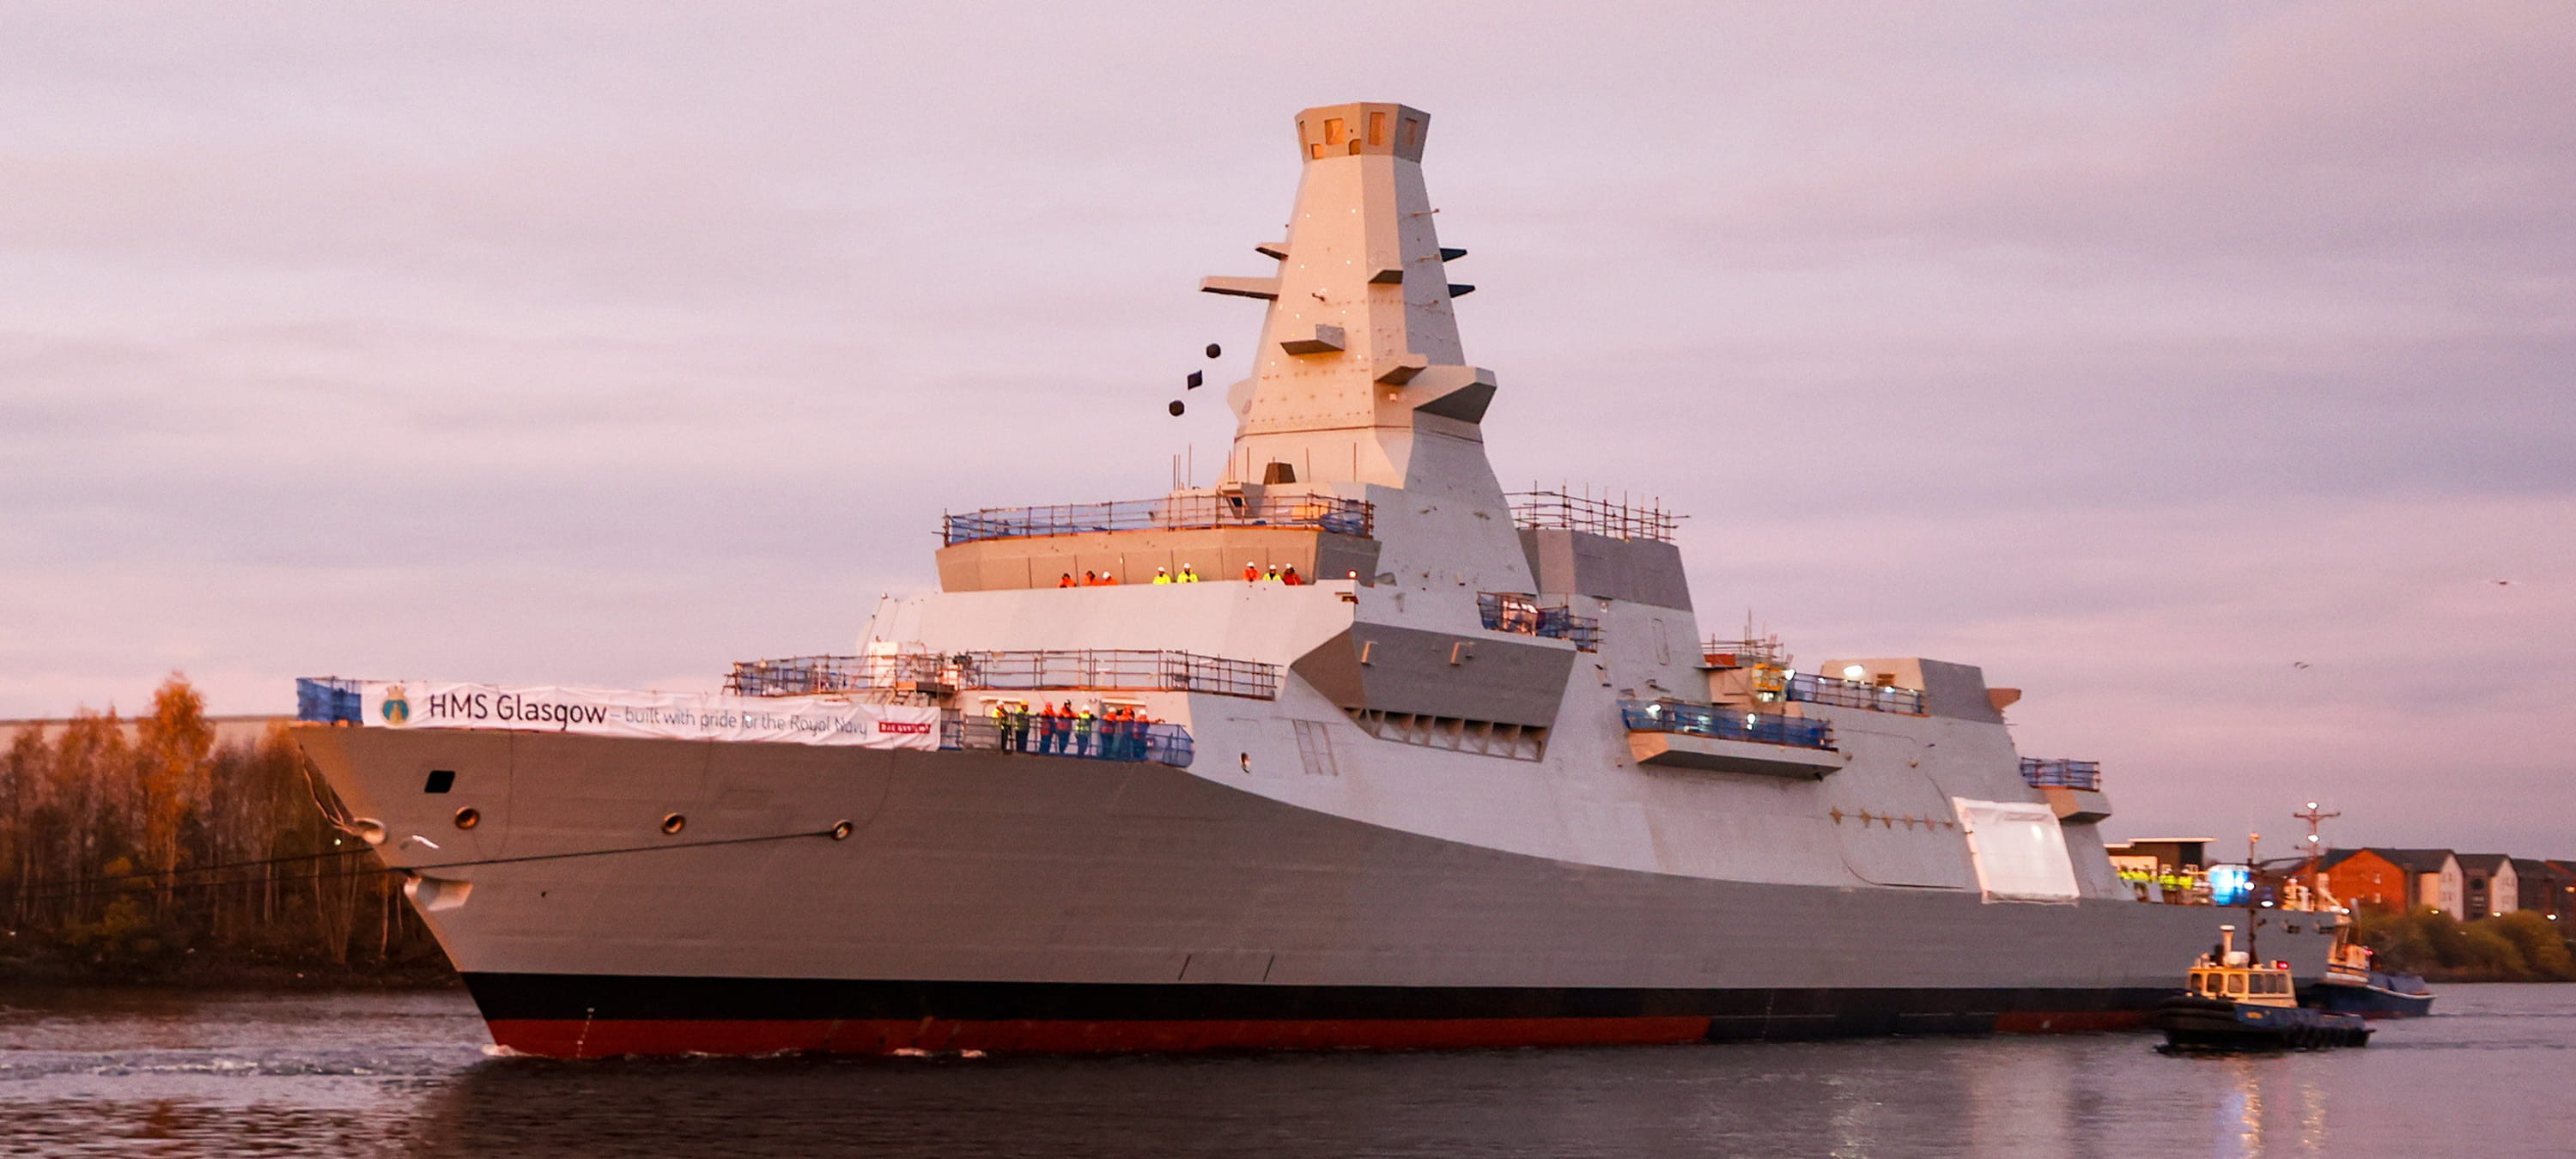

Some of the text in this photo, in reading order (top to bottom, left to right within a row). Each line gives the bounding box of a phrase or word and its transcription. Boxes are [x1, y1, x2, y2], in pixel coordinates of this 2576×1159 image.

[430, 694, 488, 719] HMS
[497, 694, 607, 731] Glasgow
[625, 707, 660, 725] built
[663, 708, 696, 725] with
[701, 710, 738, 731] pride
[742, 712, 757, 729] for
[762, 712, 786, 730] the
[790, 714, 830, 737] Royal
[835, 716, 867, 740] Navy
